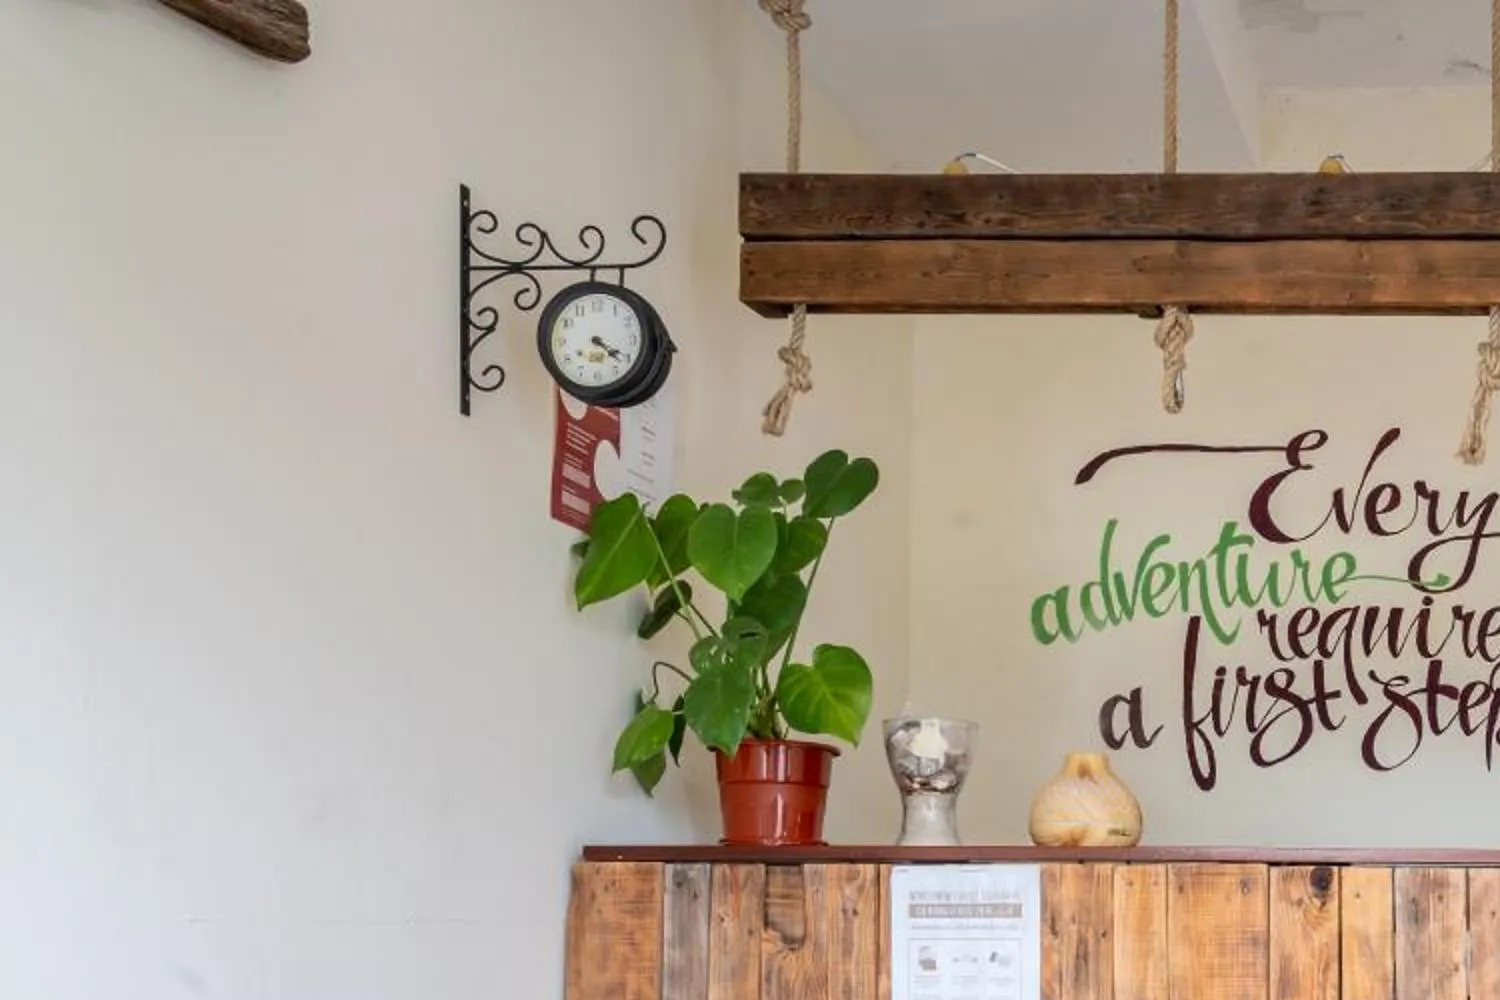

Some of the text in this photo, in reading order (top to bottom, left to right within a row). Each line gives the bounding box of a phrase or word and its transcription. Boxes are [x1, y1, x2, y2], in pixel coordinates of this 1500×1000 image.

[1030, 517, 1452, 646] adventure
[1099, 686, 1164, 750] a
[1183, 614, 1347, 793] first
